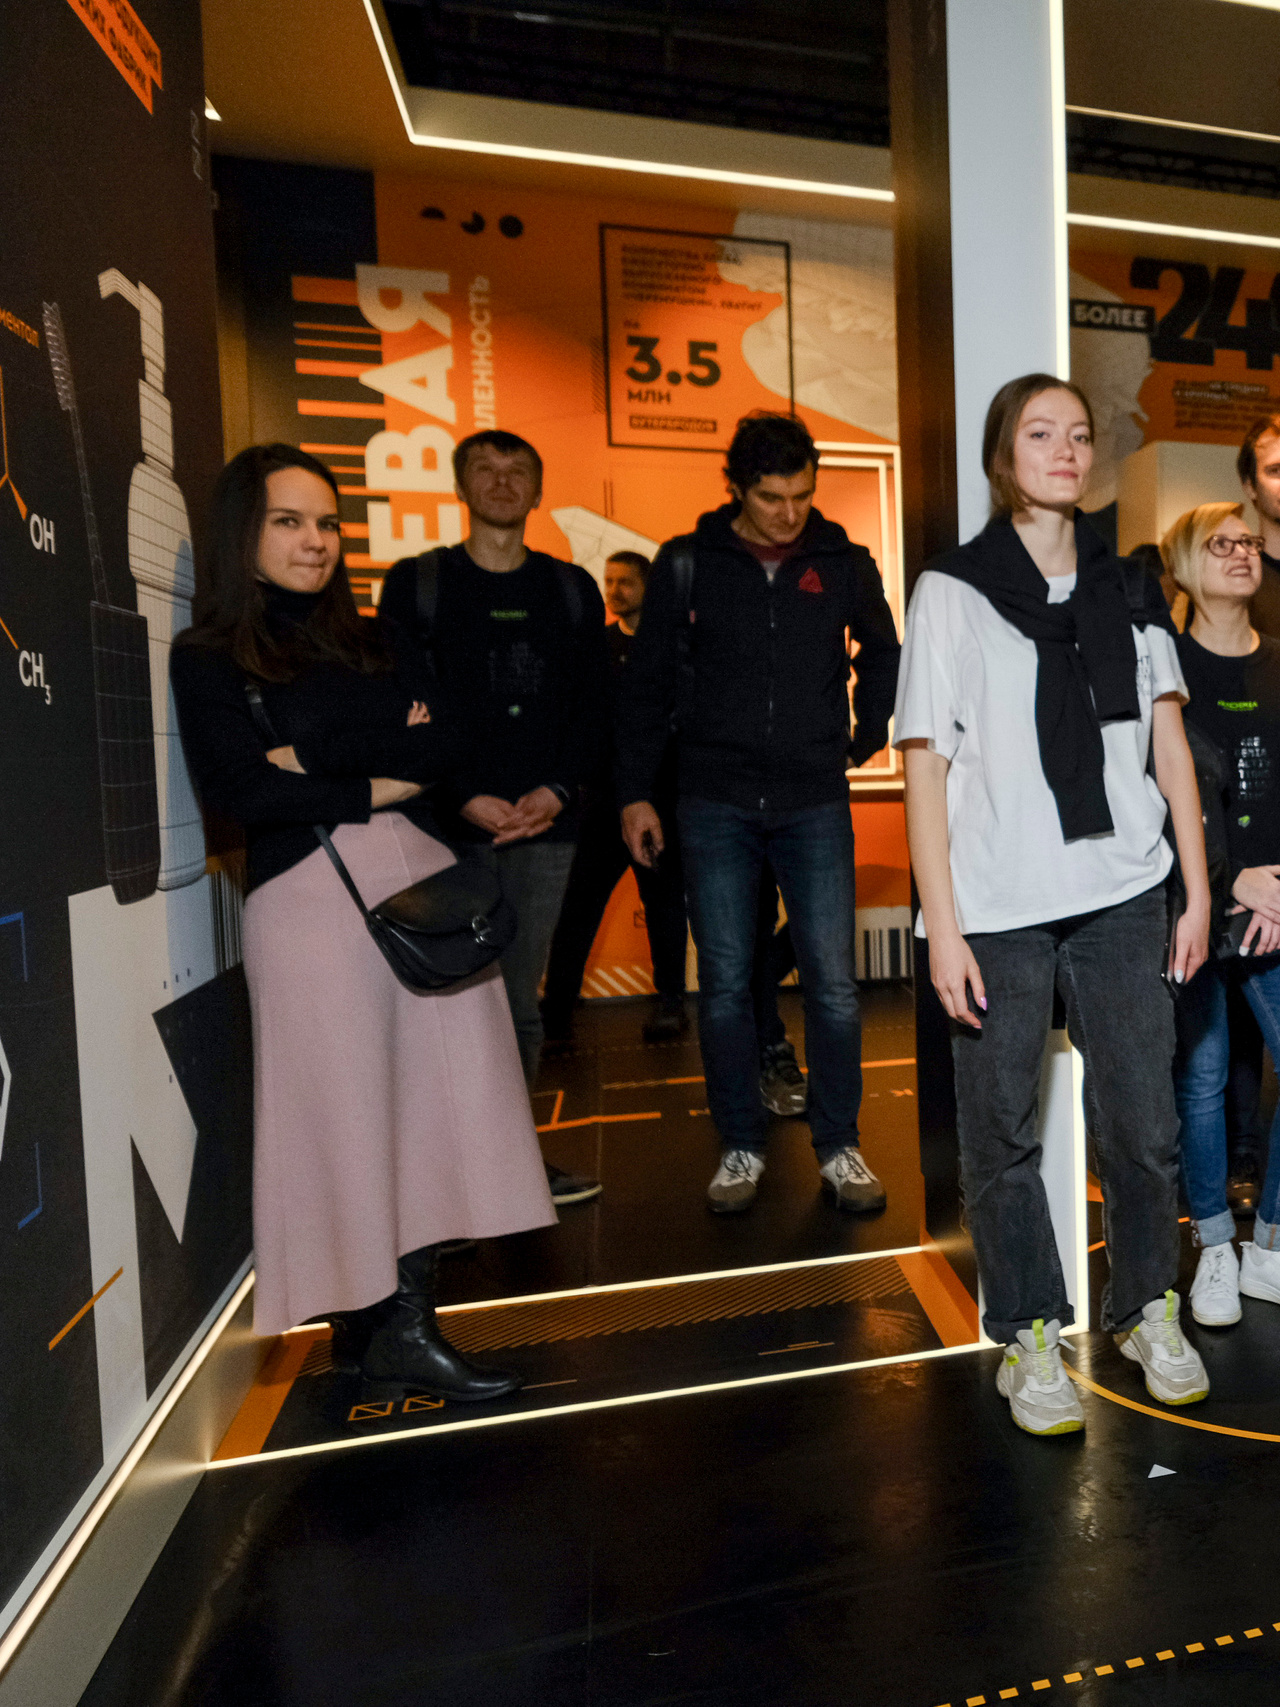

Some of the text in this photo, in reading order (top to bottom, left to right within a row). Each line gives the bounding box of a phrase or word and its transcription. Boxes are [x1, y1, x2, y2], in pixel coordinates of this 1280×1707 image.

[1073, 304, 1148, 328] БОЛЕЕ
[625, 334, 722, 387] 3.5
[627, 388, 671, 404] МЛН
[355, 262, 469, 605] ЕВАЯ
[29, 513, 56, 554] OH
